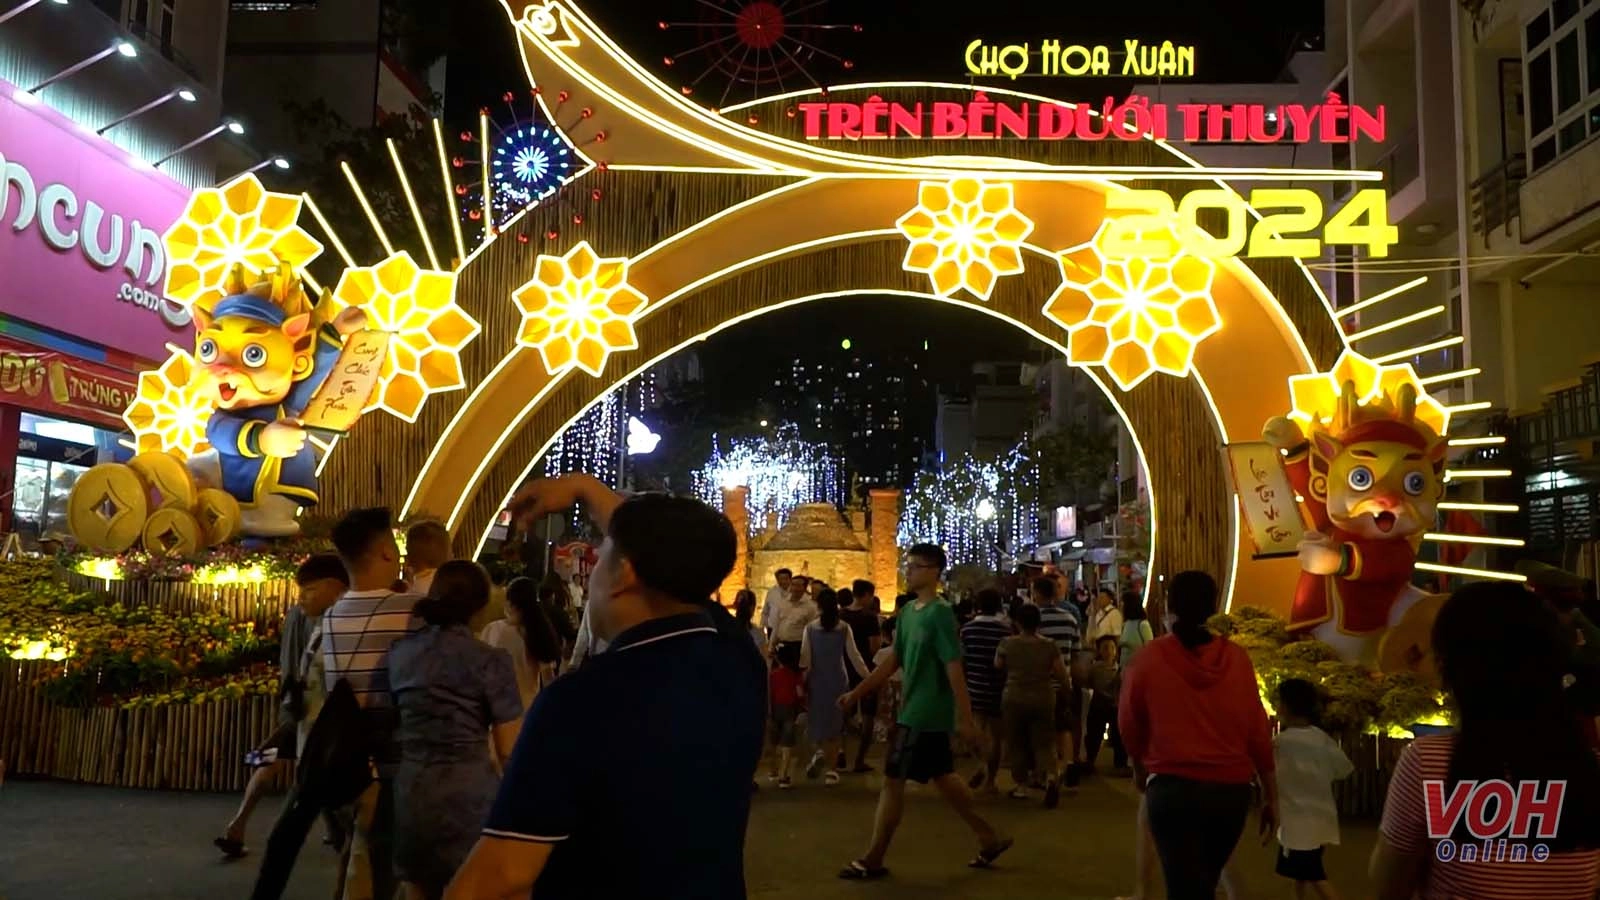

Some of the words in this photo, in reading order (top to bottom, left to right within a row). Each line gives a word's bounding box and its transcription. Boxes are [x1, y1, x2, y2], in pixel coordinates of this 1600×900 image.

[799, 94, 922, 140] TRÊN
[1039, 95, 1167, 142] DƯỚI
[1177, 91, 1386, 142] THUYỀN
[1100, 188, 1399, 258] 2024
